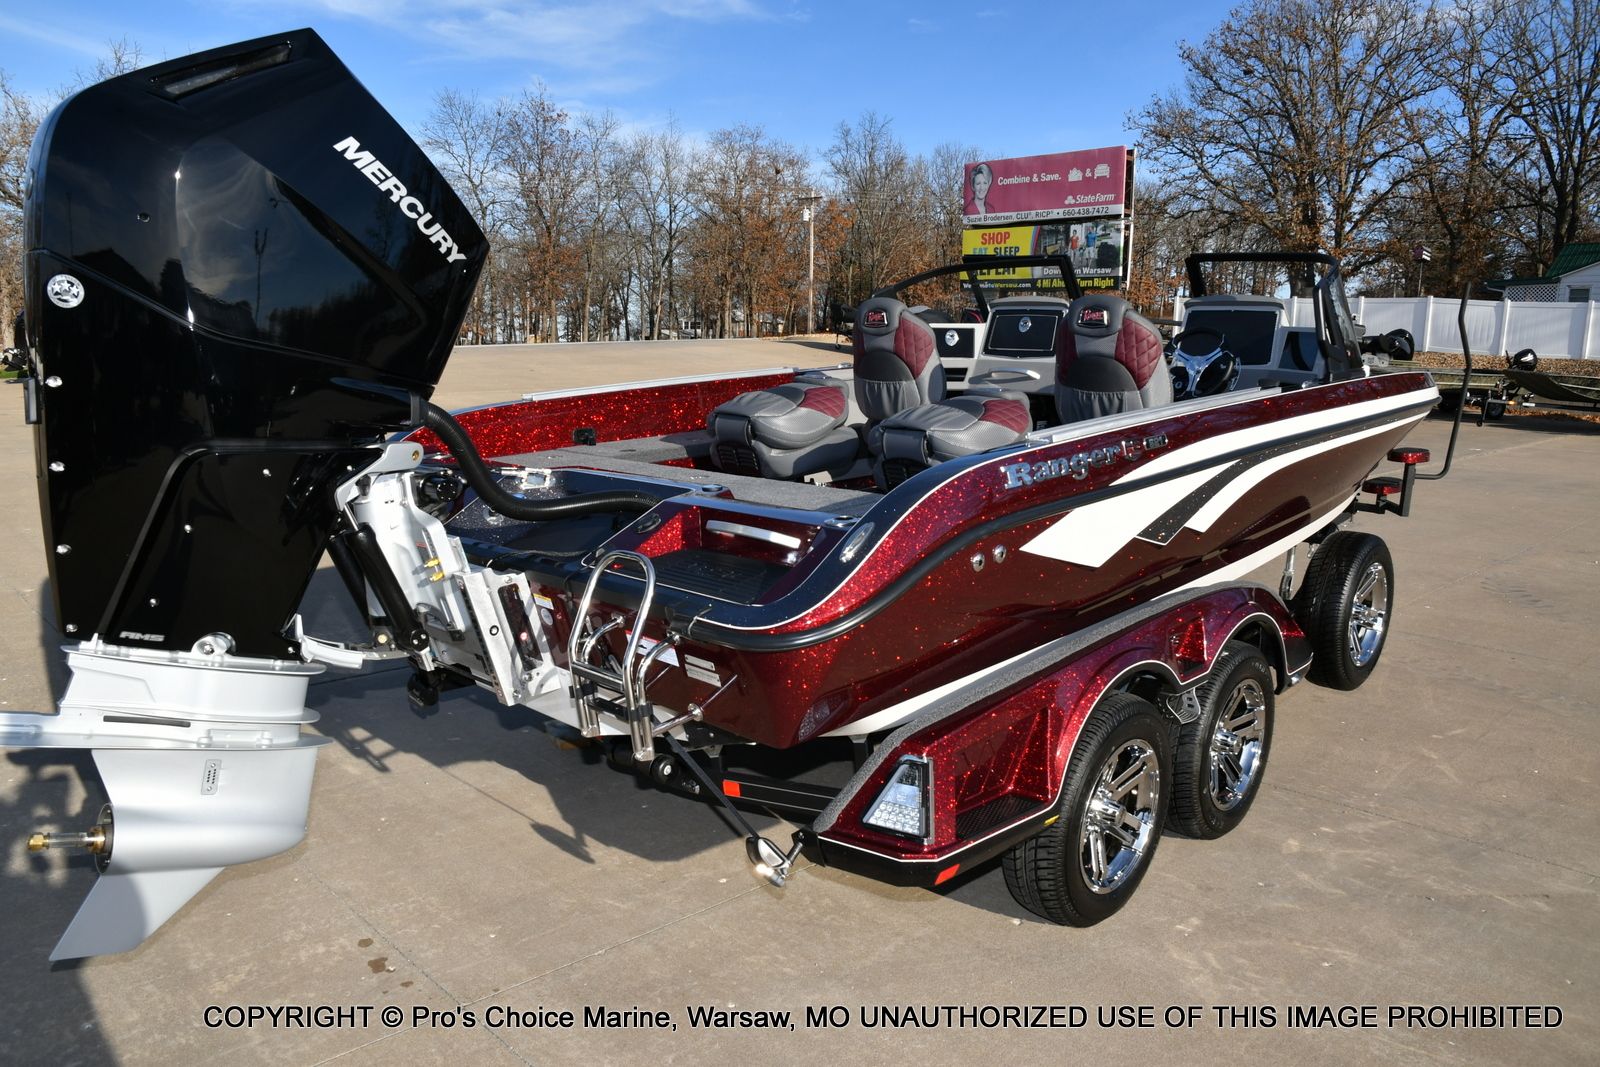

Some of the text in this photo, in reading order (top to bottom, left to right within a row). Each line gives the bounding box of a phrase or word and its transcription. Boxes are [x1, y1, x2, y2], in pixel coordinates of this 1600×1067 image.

[997, 172, 1061, 186] Combine & Save.
[1085, 167, 1092, 178] &
[333, 136, 467, 263] MERCURY
[966, 215, 983, 223] Suzie
[983, 213, 1015, 222] Brodersen,
[1062, 206, 1109, 217] 660-438-7472
[980, 231, 1011, 245] SHOP
[993, 246, 1020, 256] SLEEP
[1082, 266, 1112, 275] Warsaw
[1036, 279, 1042, 288] 4
[1042, 278, 1051, 288] Mi
[1077, 278, 1093, 287] Turn
[1093, 278, 1114, 289] Right
[1000, 445, 1121, 490] Ranger
